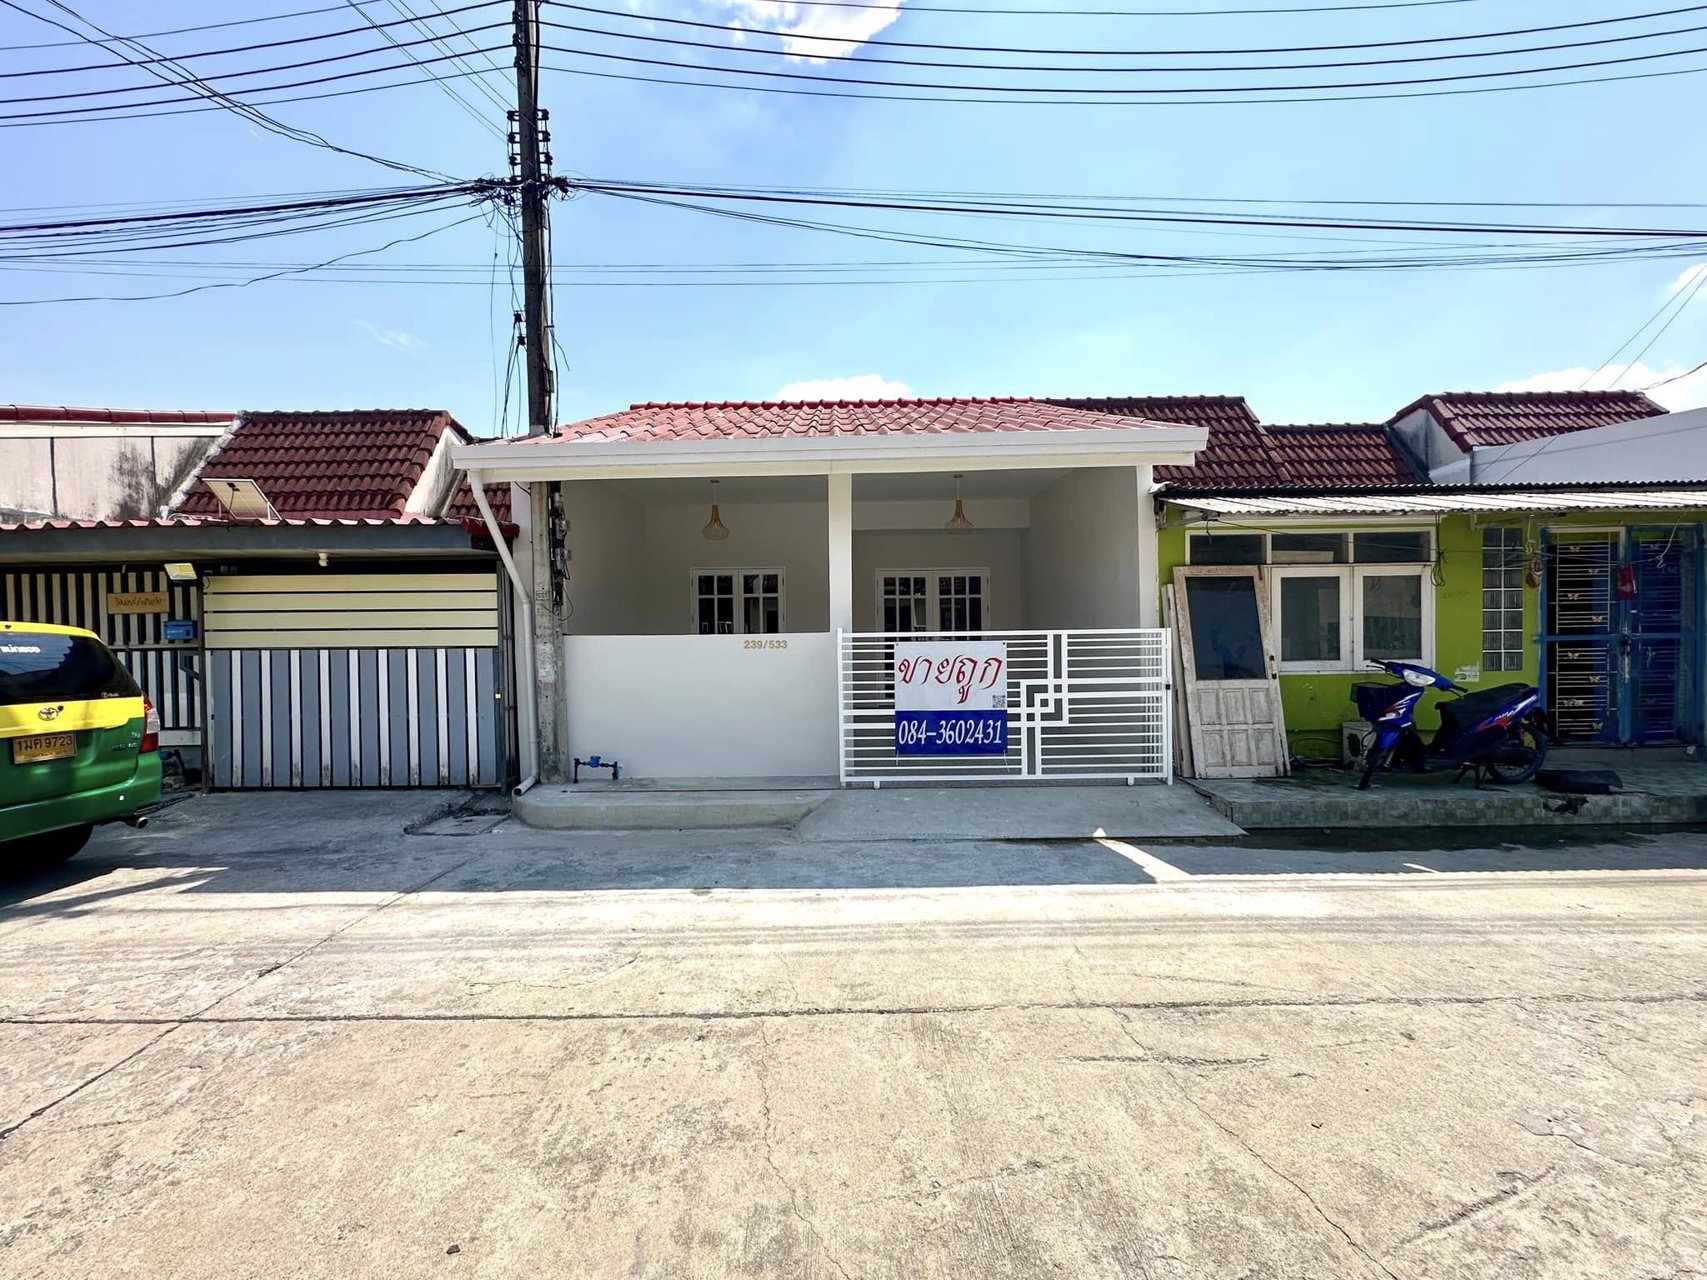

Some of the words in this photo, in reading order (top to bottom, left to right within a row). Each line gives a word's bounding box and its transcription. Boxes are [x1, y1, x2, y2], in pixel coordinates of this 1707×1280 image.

[743, 640, 788, 649] 239/533
[898, 654, 1002, 704] ขายถูก
[898, 719, 1002, 744] 084-3602431
[44, 735, 73, 748] 9723
